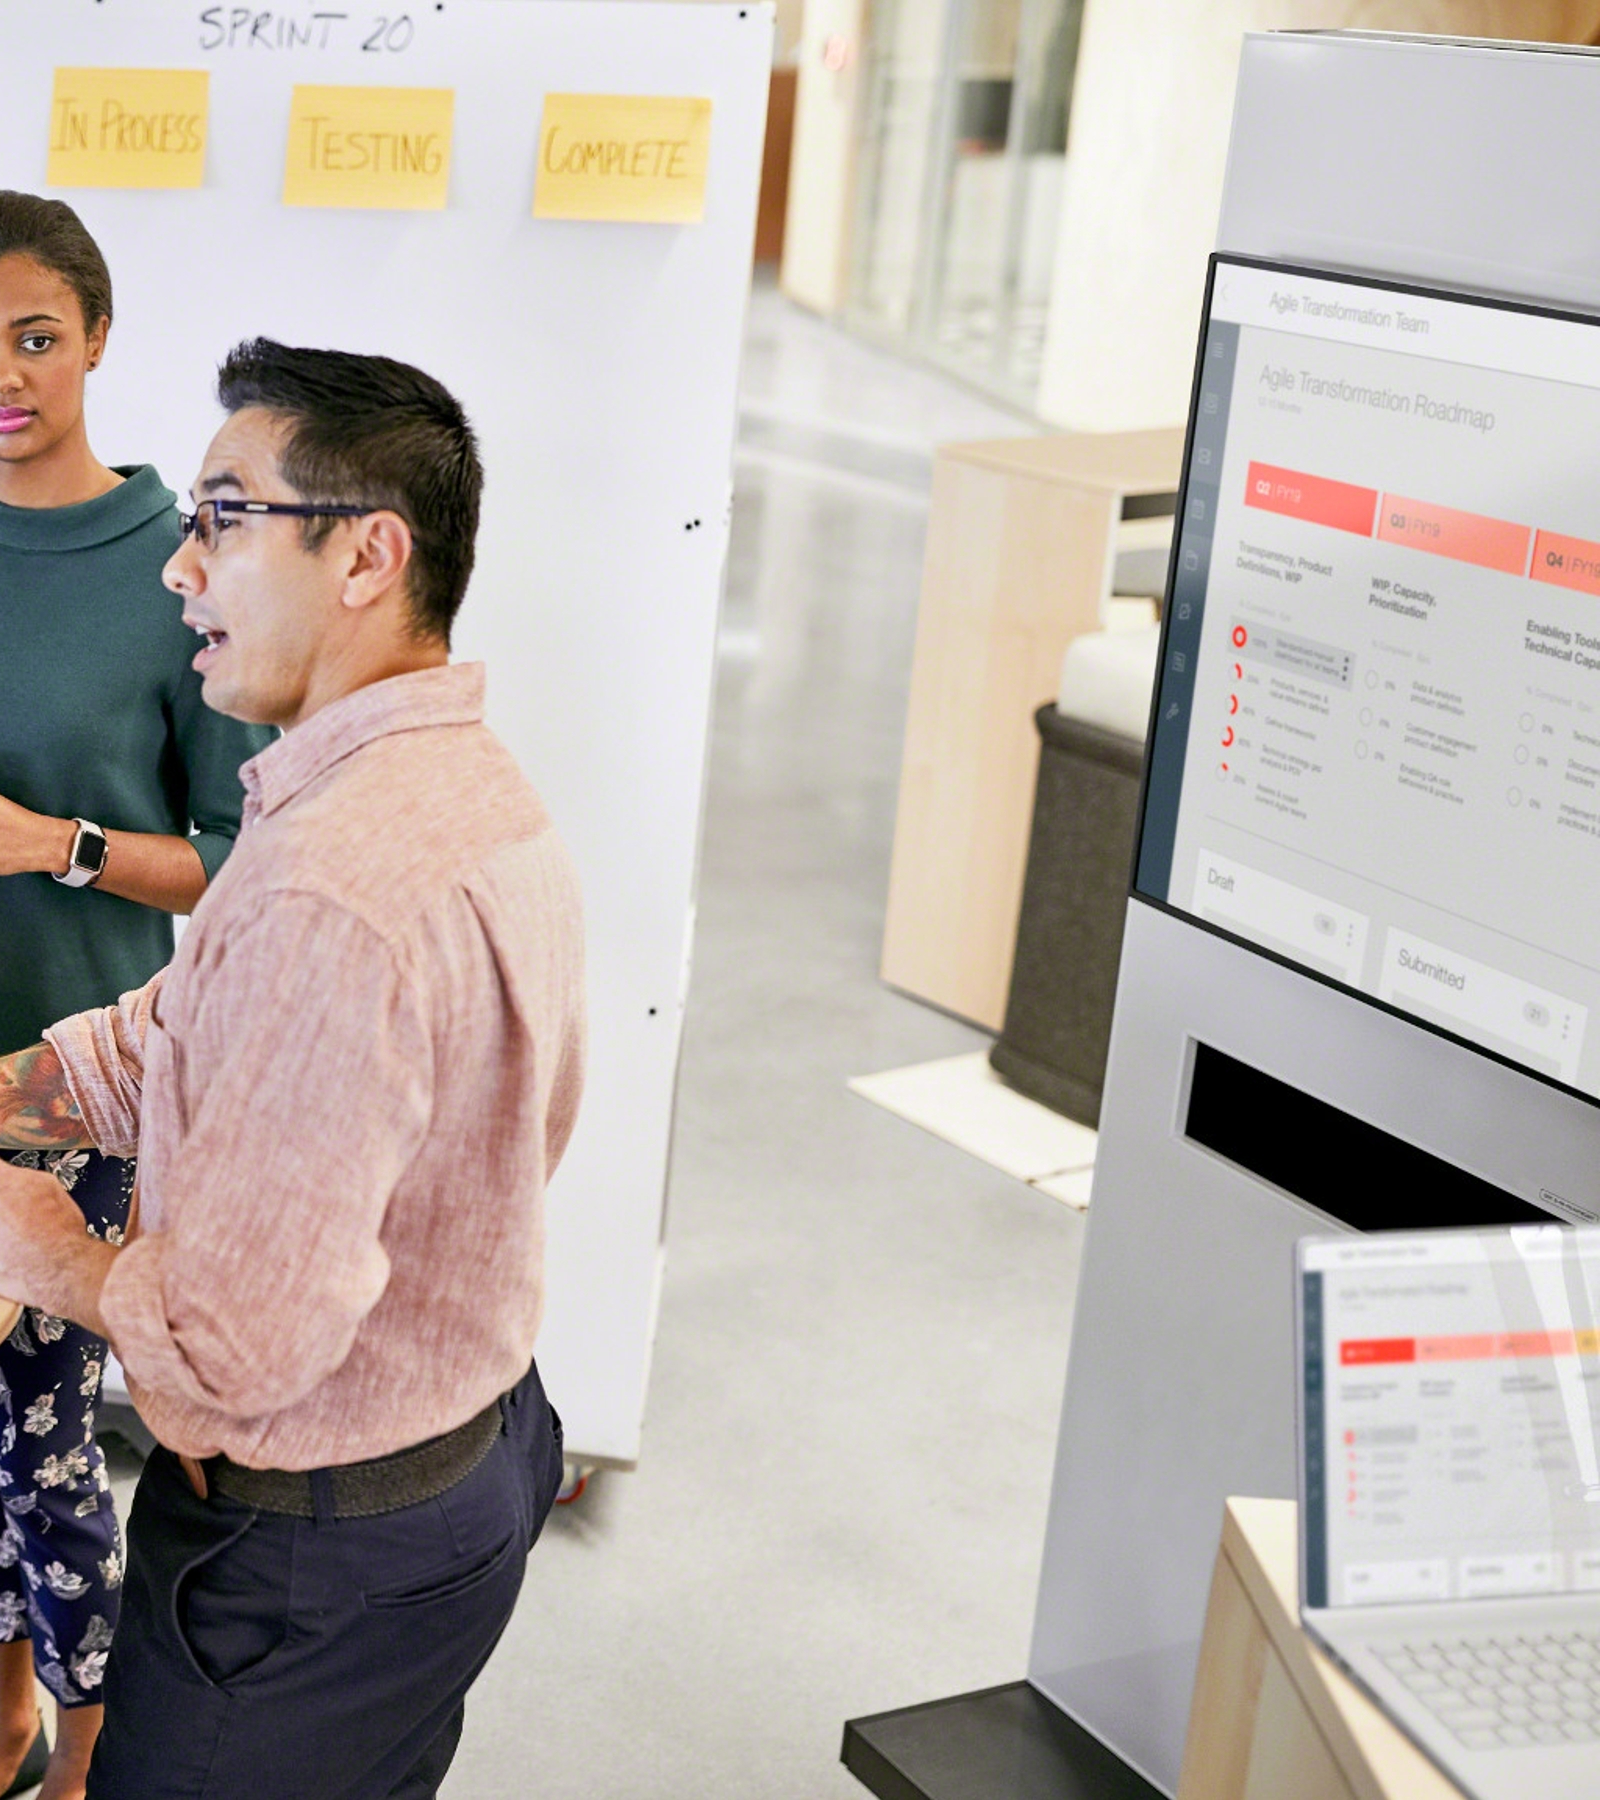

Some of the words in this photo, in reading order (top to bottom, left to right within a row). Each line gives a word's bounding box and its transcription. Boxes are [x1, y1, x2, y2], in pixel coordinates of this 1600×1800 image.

[199, 7, 348, 50] SPRINT
[362, 15, 414, 52] 20
[52, 97, 88, 152] IN
[100, 97, 202, 153] PROCESS
[301, 116, 443, 175] TESTING
[543, 126, 691, 179] COMPLETE
[1269, 291, 1298, 315] Agile
[1302, 296, 1391, 328] Transformation
[1396, 311, 1430, 334] Team
[1259, 364, 1295, 392] Agile
[1299, 371, 1410, 414] Transformation
[1414, 394, 1497, 434] Roadmap
[1256, 480, 1271, 495] Q2
[1390, 513, 1406, 529] Q3
[1298, 557, 1334, 577] Product
[1546, 552, 1564, 569] Q4
[1285, 570, 1303, 584] WIP
[1369, 594, 1428, 620] Prioritization
[1526, 619, 1571, 645] Enabling
[1524, 638, 1572, 662] Technical
[1207, 867, 1235, 894] Draft
[1397, 948, 1466, 991] Submitted
